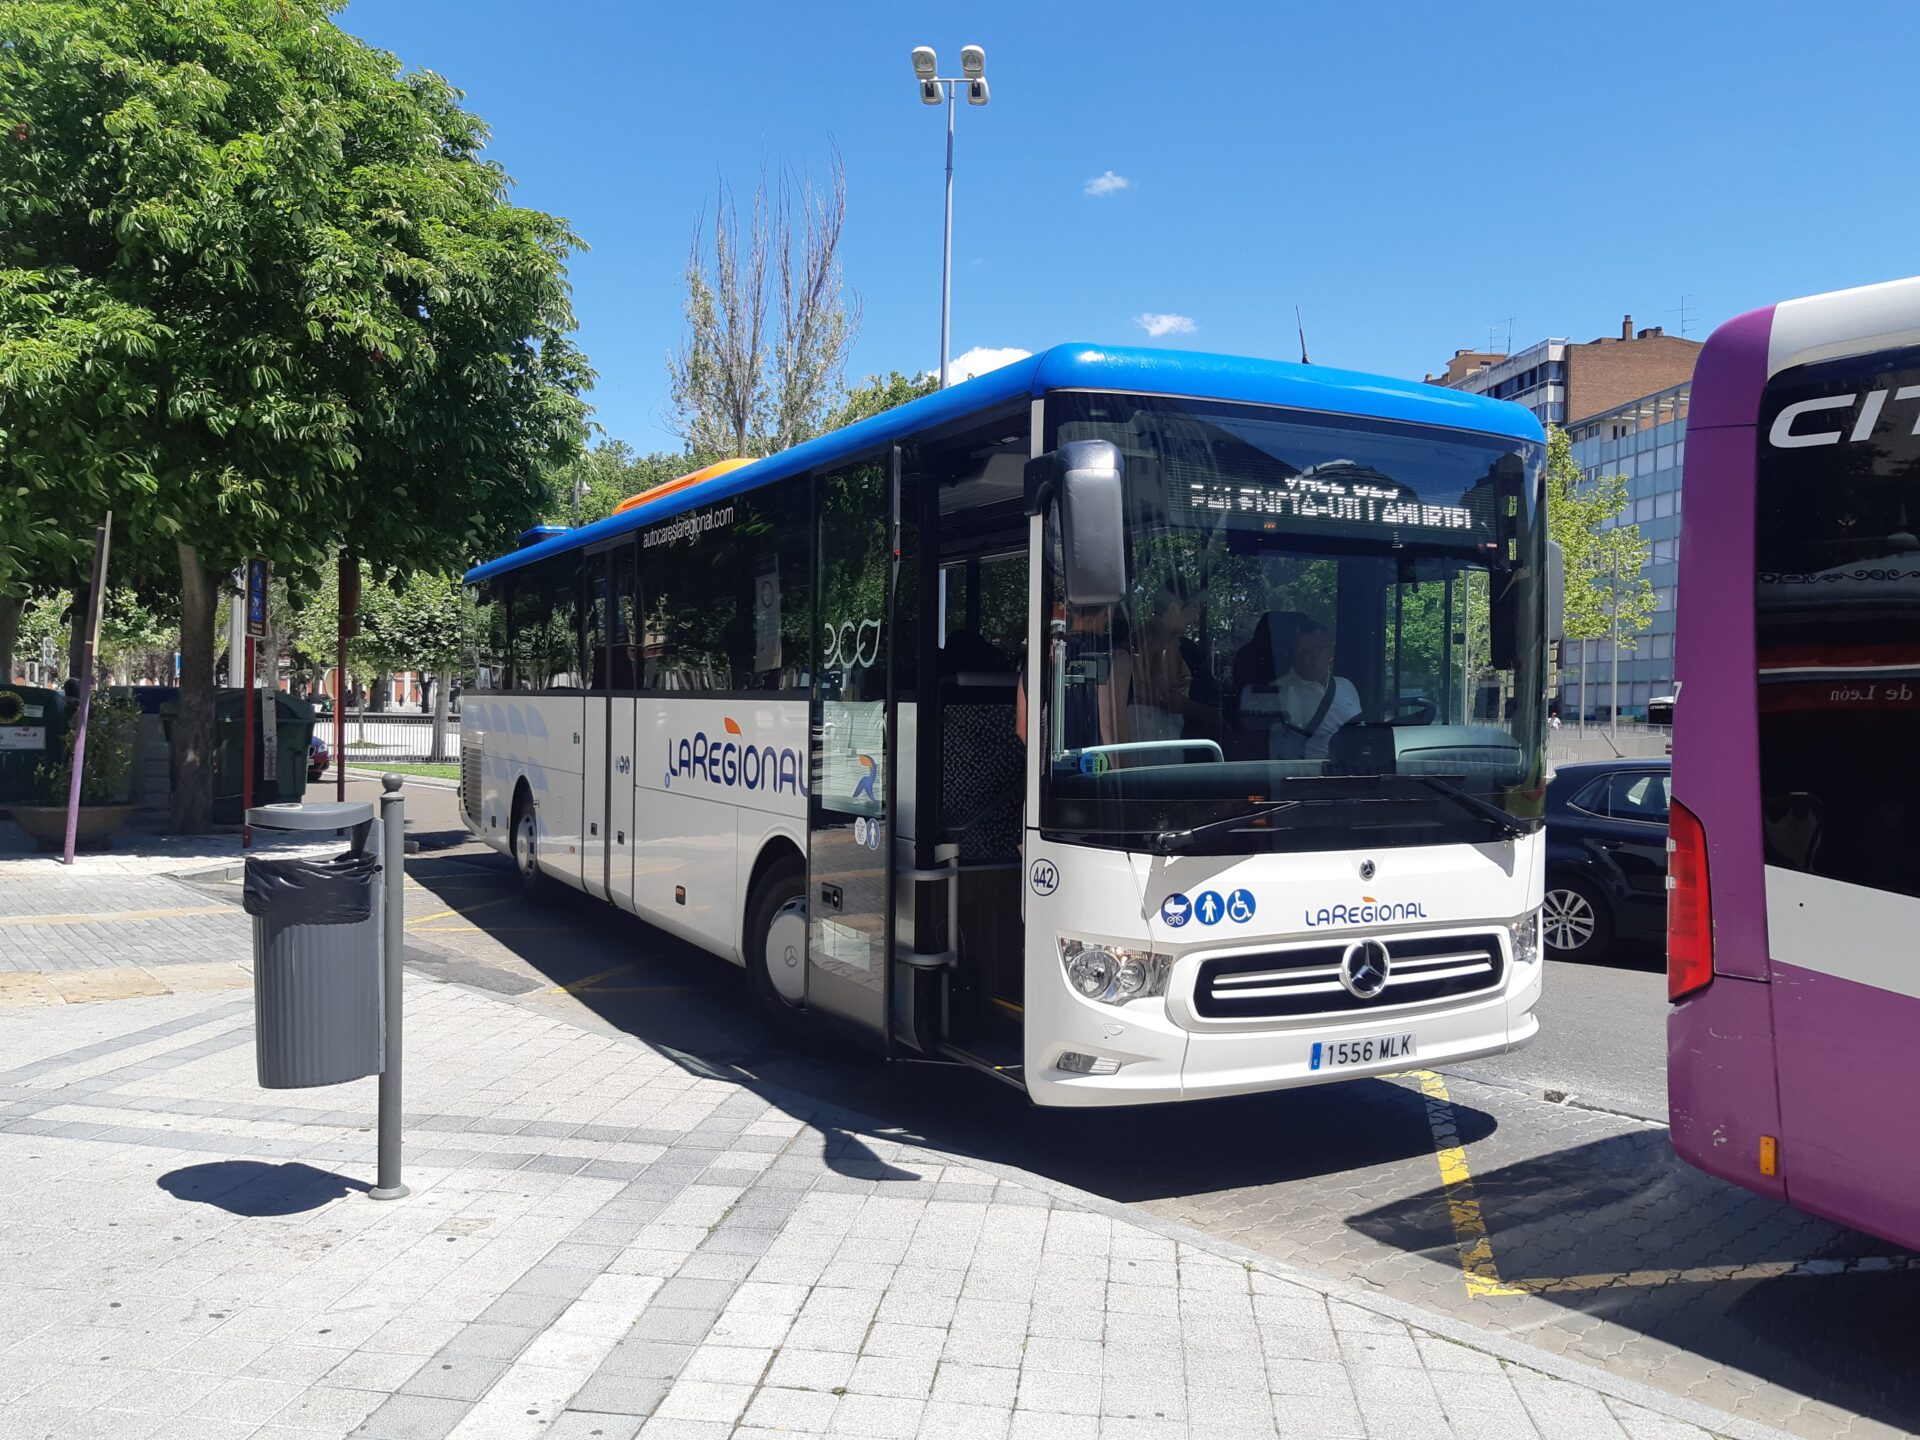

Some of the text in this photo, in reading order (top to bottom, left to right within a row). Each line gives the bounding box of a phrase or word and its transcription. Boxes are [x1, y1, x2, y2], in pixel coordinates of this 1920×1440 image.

[643, 506, 734, 548] autocareslaregional.com
[1033, 867, 1055, 889] 442
[1328, 1041, 1374, 1065] 1556
[1379, 1034, 1412, 1060] MLK
